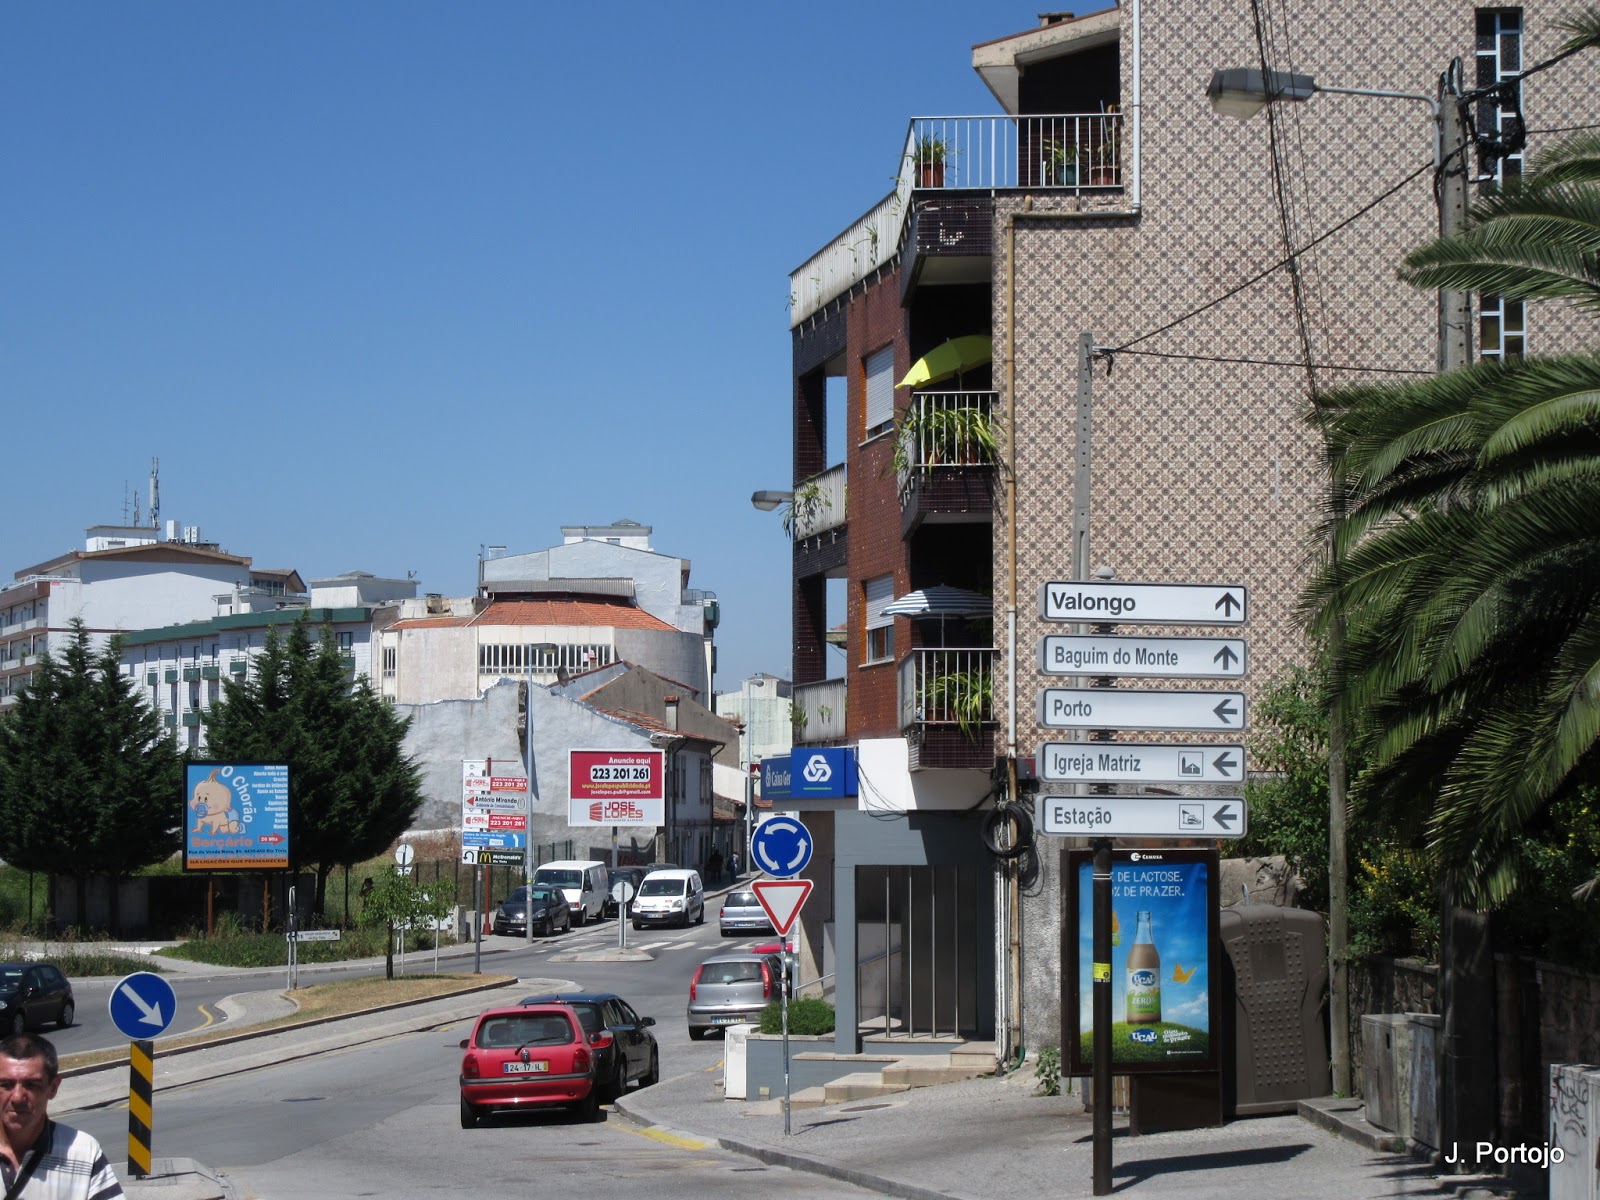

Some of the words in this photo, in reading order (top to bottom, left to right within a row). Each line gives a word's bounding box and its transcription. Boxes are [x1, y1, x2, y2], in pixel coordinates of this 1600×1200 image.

[1052, 592, 1136, 616] Valongo
[1054, 646, 1108, 668] Baguim
[1114, 648, 1130, 665] do
[1136, 648, 1178, 666] Monte
[1054, 699, 1092, 717] Porto
[1054, 753, 1094, 775] Igreja
[1098, 754, 1140, 772] Matriz
[592, 768, 610, 779] 223
[613, 768, 630, 779] 201
[633, 768, 649, 779] 261
[221, 766, 234, 778] O
[232, 776, 256, 822] Chorão
[605, 810, 643, 818] LOPES
[1054, 806, 1112, 828] Estação
[192, 837, 254, 848] Berçário
[1118, 872, 1130, 882] DE
[1134, 871, 1183, 882] LACTOSE.
[1124, 886, 1136, 896] DE
[1140, 886, 1185, 896] PRAZER.
[1132, 1031, 1157, 1042] UCAL
